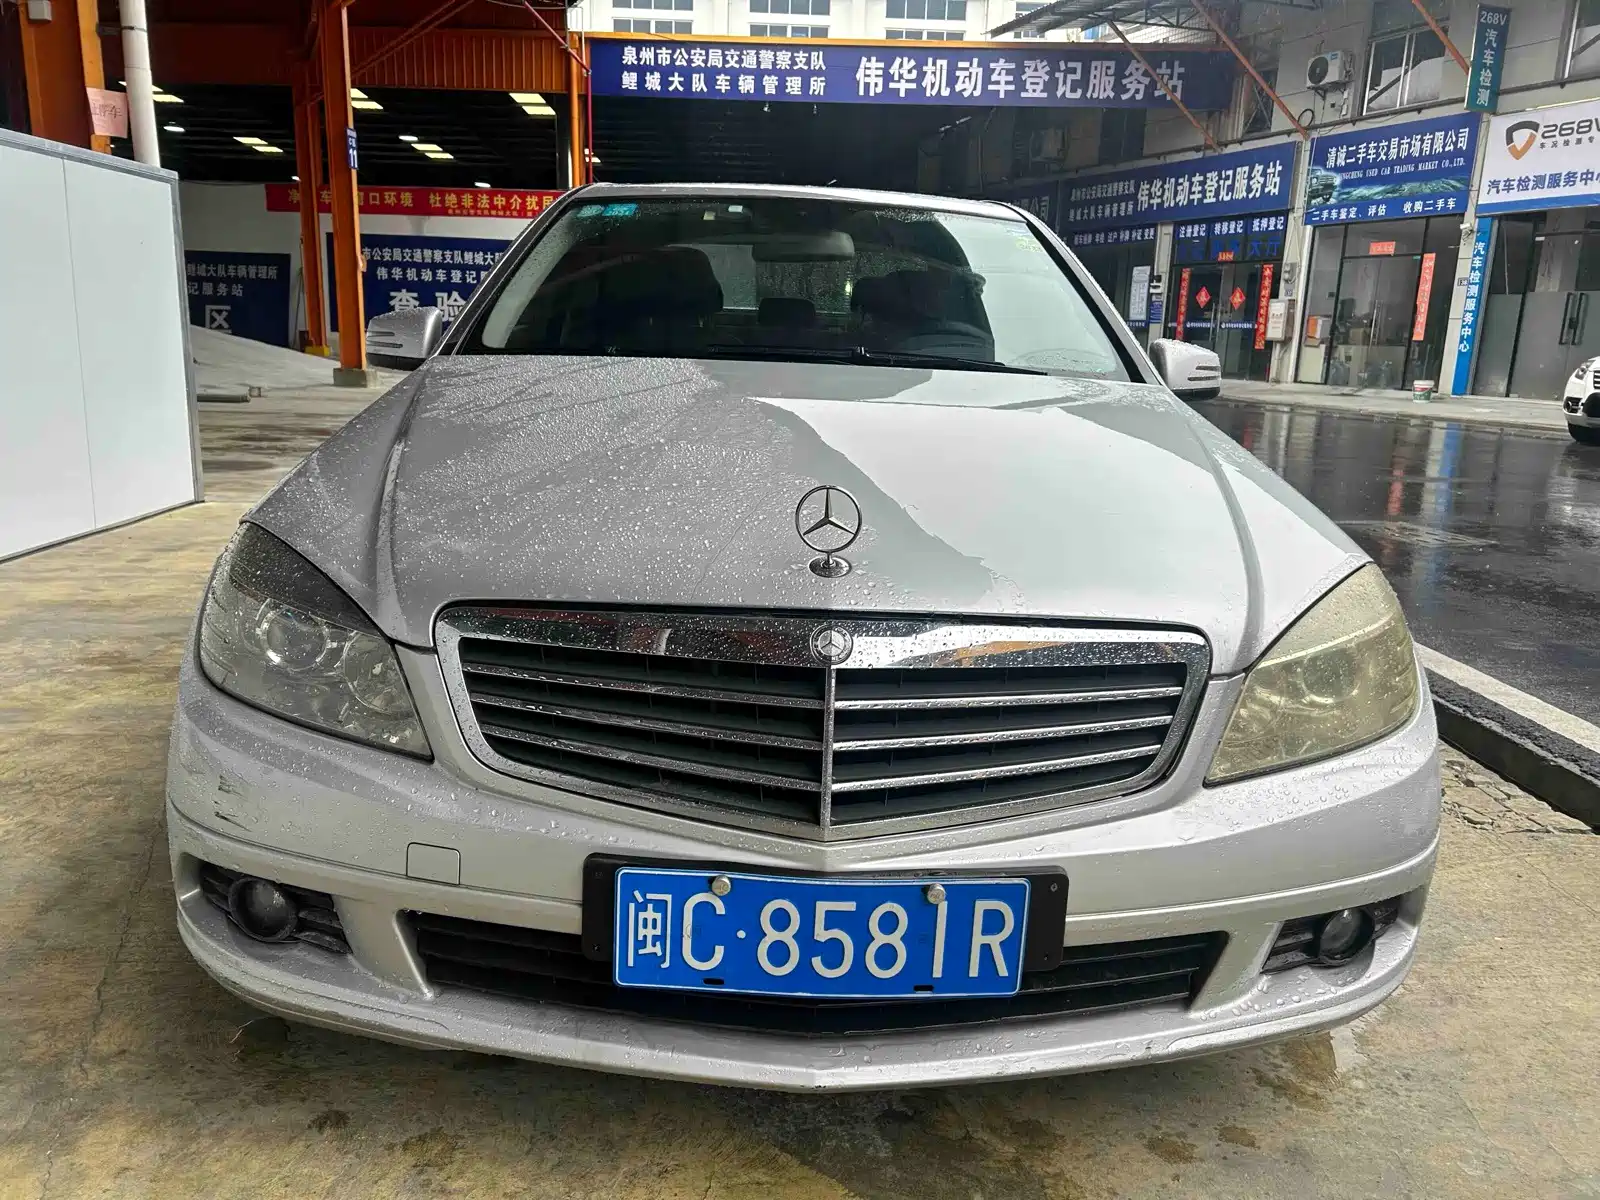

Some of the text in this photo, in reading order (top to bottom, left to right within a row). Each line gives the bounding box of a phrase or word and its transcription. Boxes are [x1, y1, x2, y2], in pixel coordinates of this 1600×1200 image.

[1480, 11, 1507, 25] 268V
[622, 45, 827, 71] 泉州市公安局交通警察支队
[1476, 28, 1498, 107] 汽车检测
[621, 71, 827, 96] 鲤城大队车辆管理所
[855, 56, 1186, 101] 伟华机动车登记服务站
[349, 148, 358, 168] 11
[1326, 127, 1469, 169] 清诚二手车交易市场有限公司
[1137, 160, 1282, 212] 伟华机动车登记服务站
[1403, 198, 1457, 214] 收购二手车
[1180, 215, 1284, 238] 注册登记 转移登记 抵押登记
[188, 281, 244, 297] 记服务站
[1459, 242, 1486, 352] 汽车检测服务中心
[205, 304, 232, 334] 区
